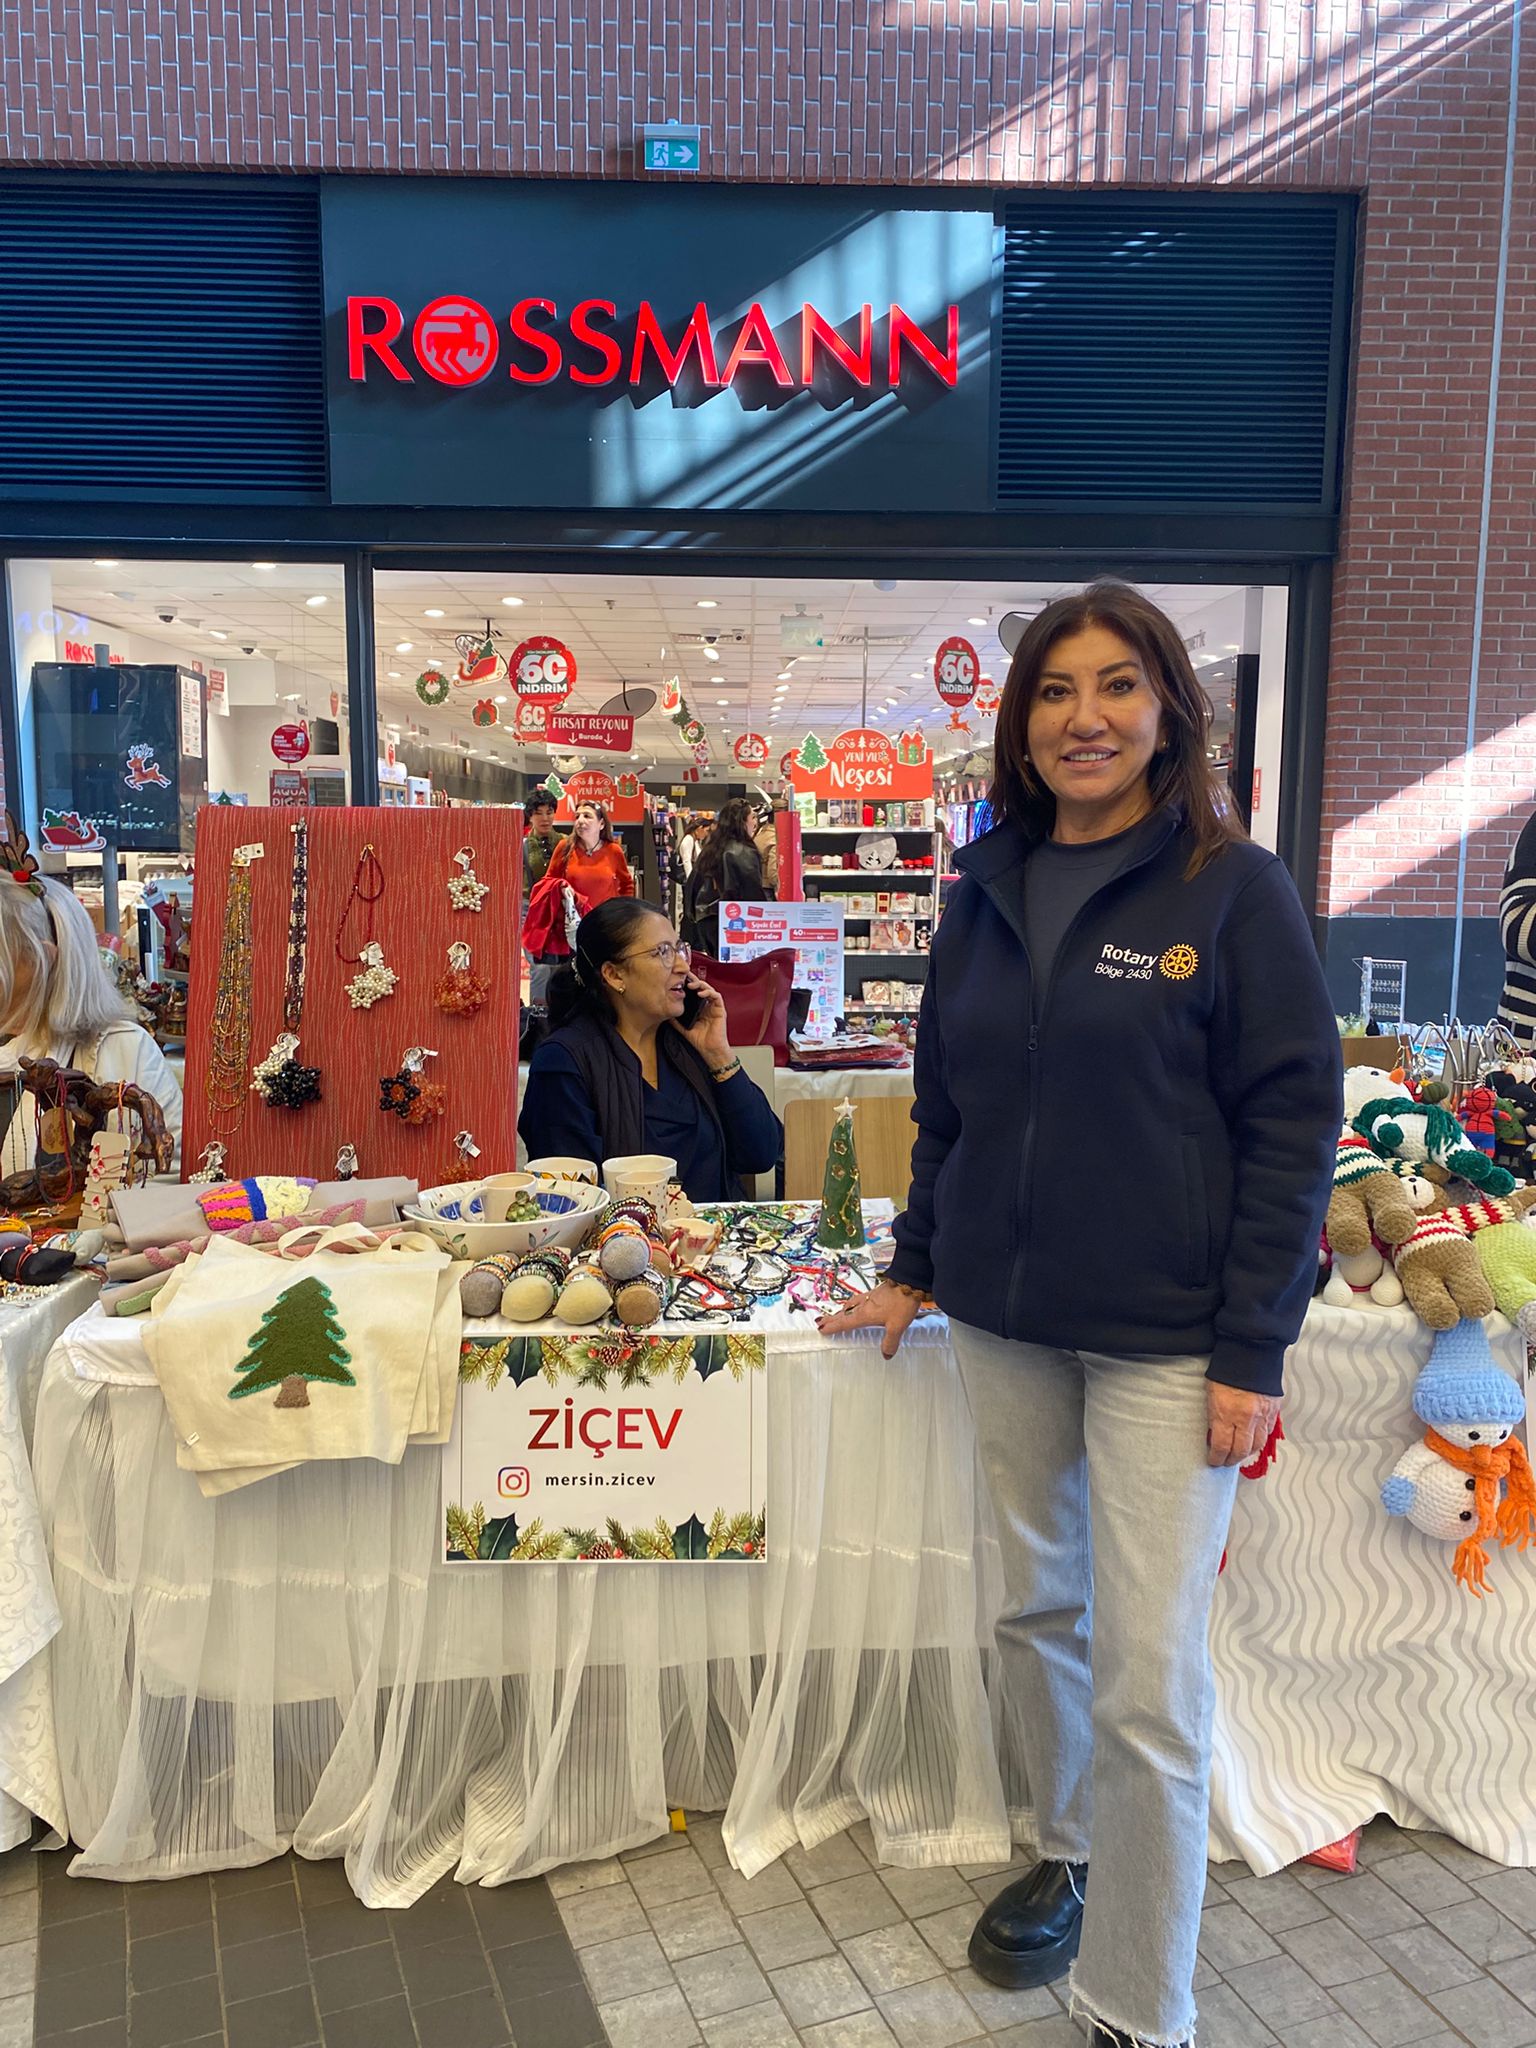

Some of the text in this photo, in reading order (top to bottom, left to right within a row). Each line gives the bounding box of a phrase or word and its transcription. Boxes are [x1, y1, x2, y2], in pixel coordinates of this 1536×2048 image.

[347, 294, 959, 388] ROSSMANN
[552, 716, 629, 730] FIRSAT REYONU
[578, 733, 603, 741] Burada
[844, 751, 864, 762] YENİ
[830, 763, 893, 792] Neşesi
[272, 786, 308, 796] AQUA
[1101, 943, 1159, 969] Rotary
[1094, 962, 1153, 980] Bölge 2430
[528, 1397, 684, 1459] ZİÇEV
[545, 1472, 656, 1487] mersin.zicev
